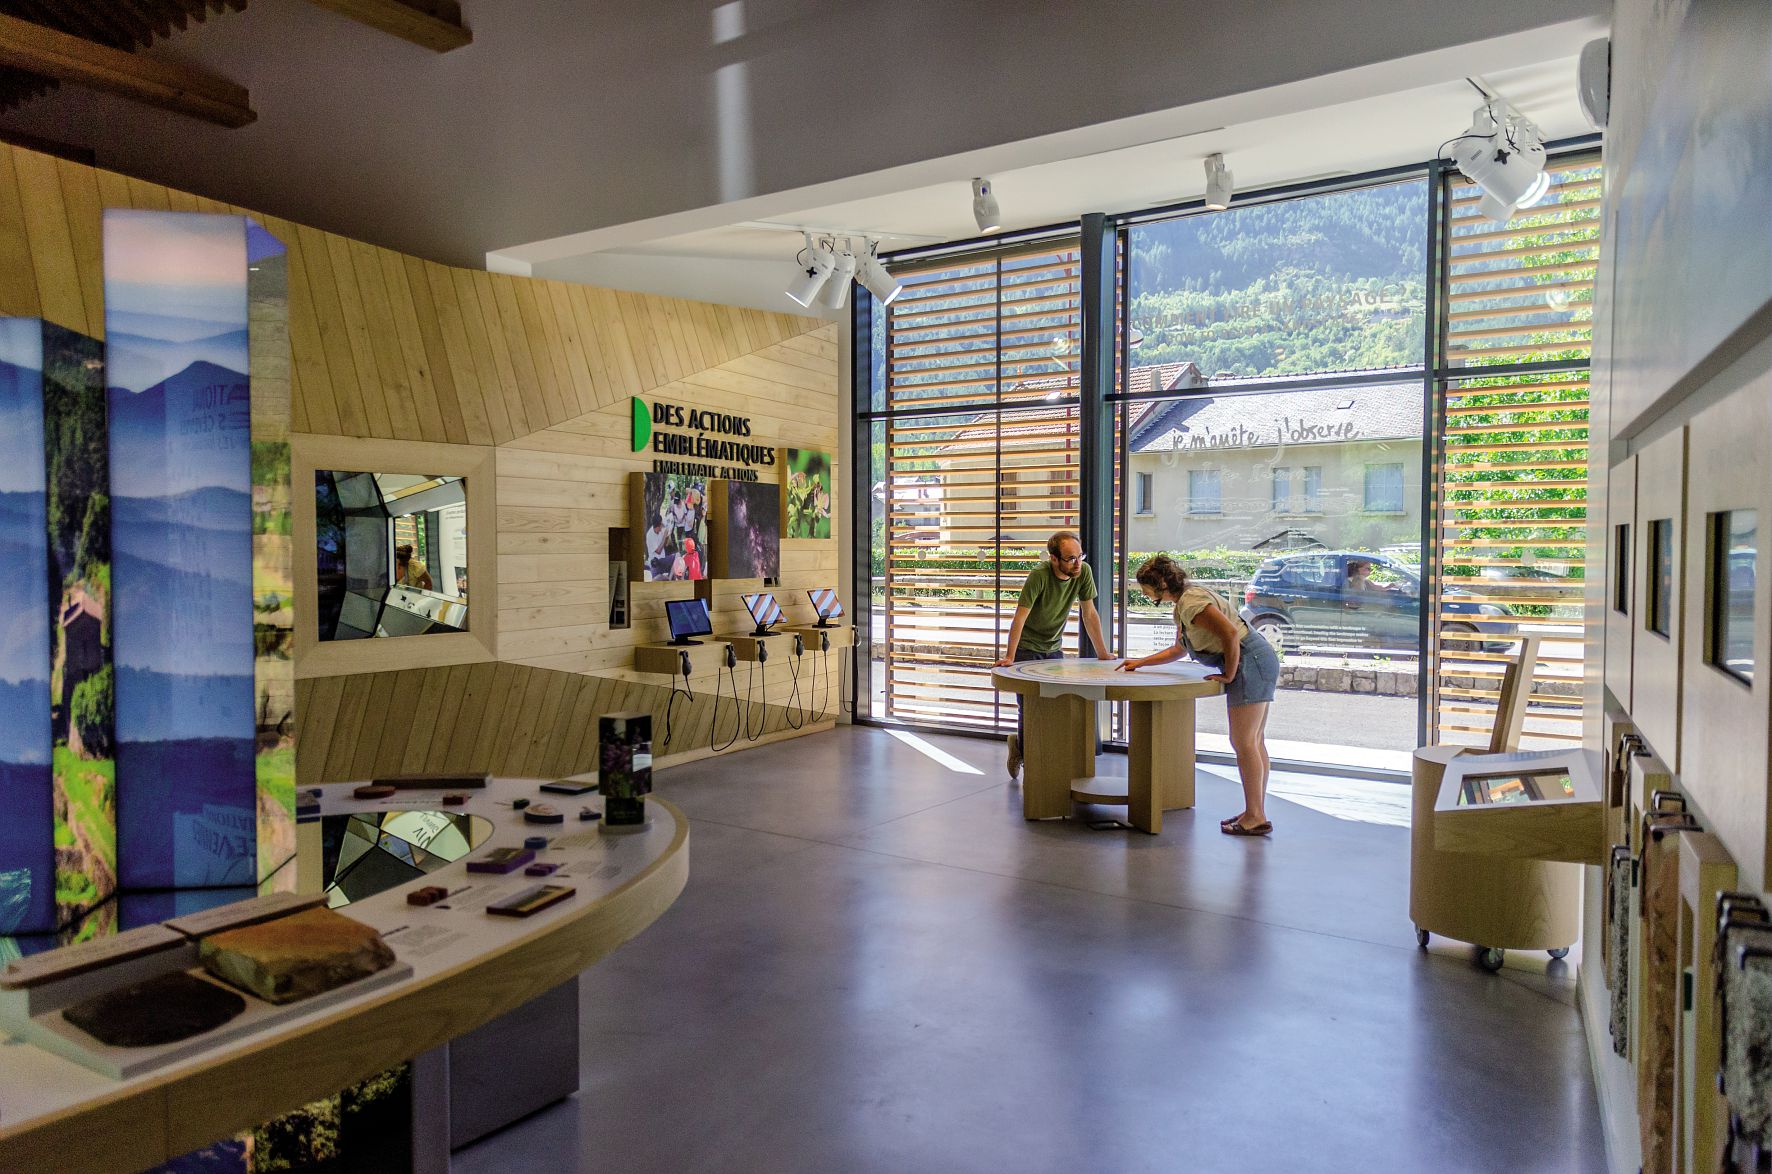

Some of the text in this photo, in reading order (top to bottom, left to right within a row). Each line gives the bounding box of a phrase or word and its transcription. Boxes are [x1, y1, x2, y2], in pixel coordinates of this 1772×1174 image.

[653, 402, 751, 437] DES ACTIONS
[653, 432, 775, 466] EMBLÉMATIQUES
[653, 459, 759, 482] EMBLEMATIC ACTIONS
